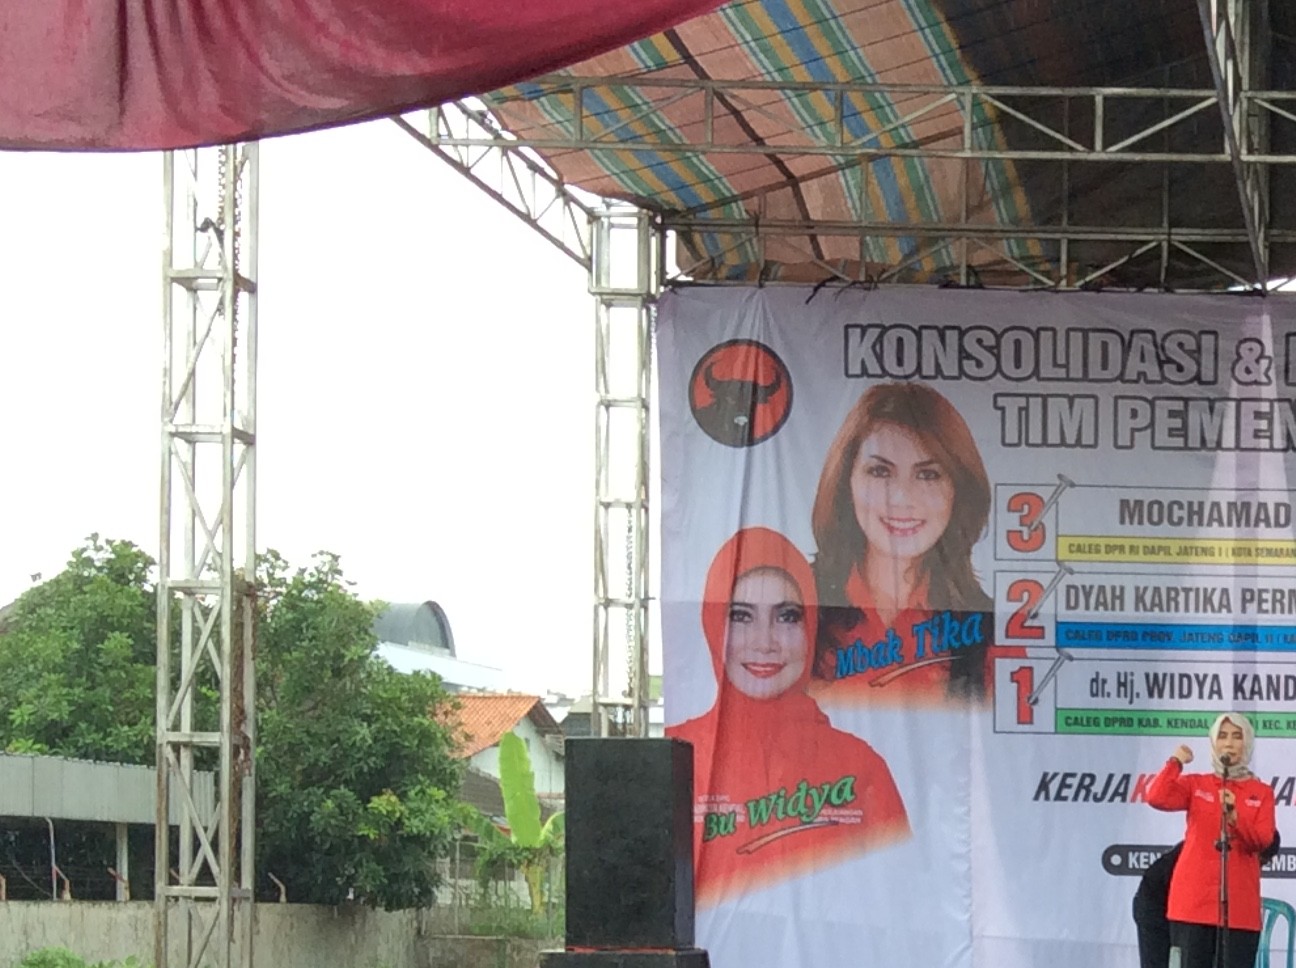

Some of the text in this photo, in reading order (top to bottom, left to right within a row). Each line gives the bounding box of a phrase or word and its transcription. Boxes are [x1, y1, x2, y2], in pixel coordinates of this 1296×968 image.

[843, 323, 1218, 385] KONSOLIDASI
[1231, 338, 1272, 386] &
[994, 393, 1099, 449] TIM
[1005, 491, 1047, 553] 3
[1118, 498, 1292, 529] MOCHAMAD
[1068, 543, 1102, 554] CALEG
[1104, 543, 1126, 555] DPR
[1129, 544, 1140, 555] RI
[1142, 544, 1173, 556] DAPIL
[1176, 545, 1215, 557] JATENG
[1005, 578, 1046, 640] 2
[1064, 584, 1126, 613] DYAH
[1134, 585, 1232, 614] KARTIKA
[834, 609, 985, 678] Mbak Tika
[1009, 665, 1035, 726] 1
[1144, 672, 1224, 701] WIDYA
[1064, 715, 1101, 728] CALEG
[1103, 716, 1134, 728] DPRD
[1166, 717, 1210, 730] KENDAL
[1262, 719, 1284, 731] KEC.
[745, 774, 857, 828] Widya
